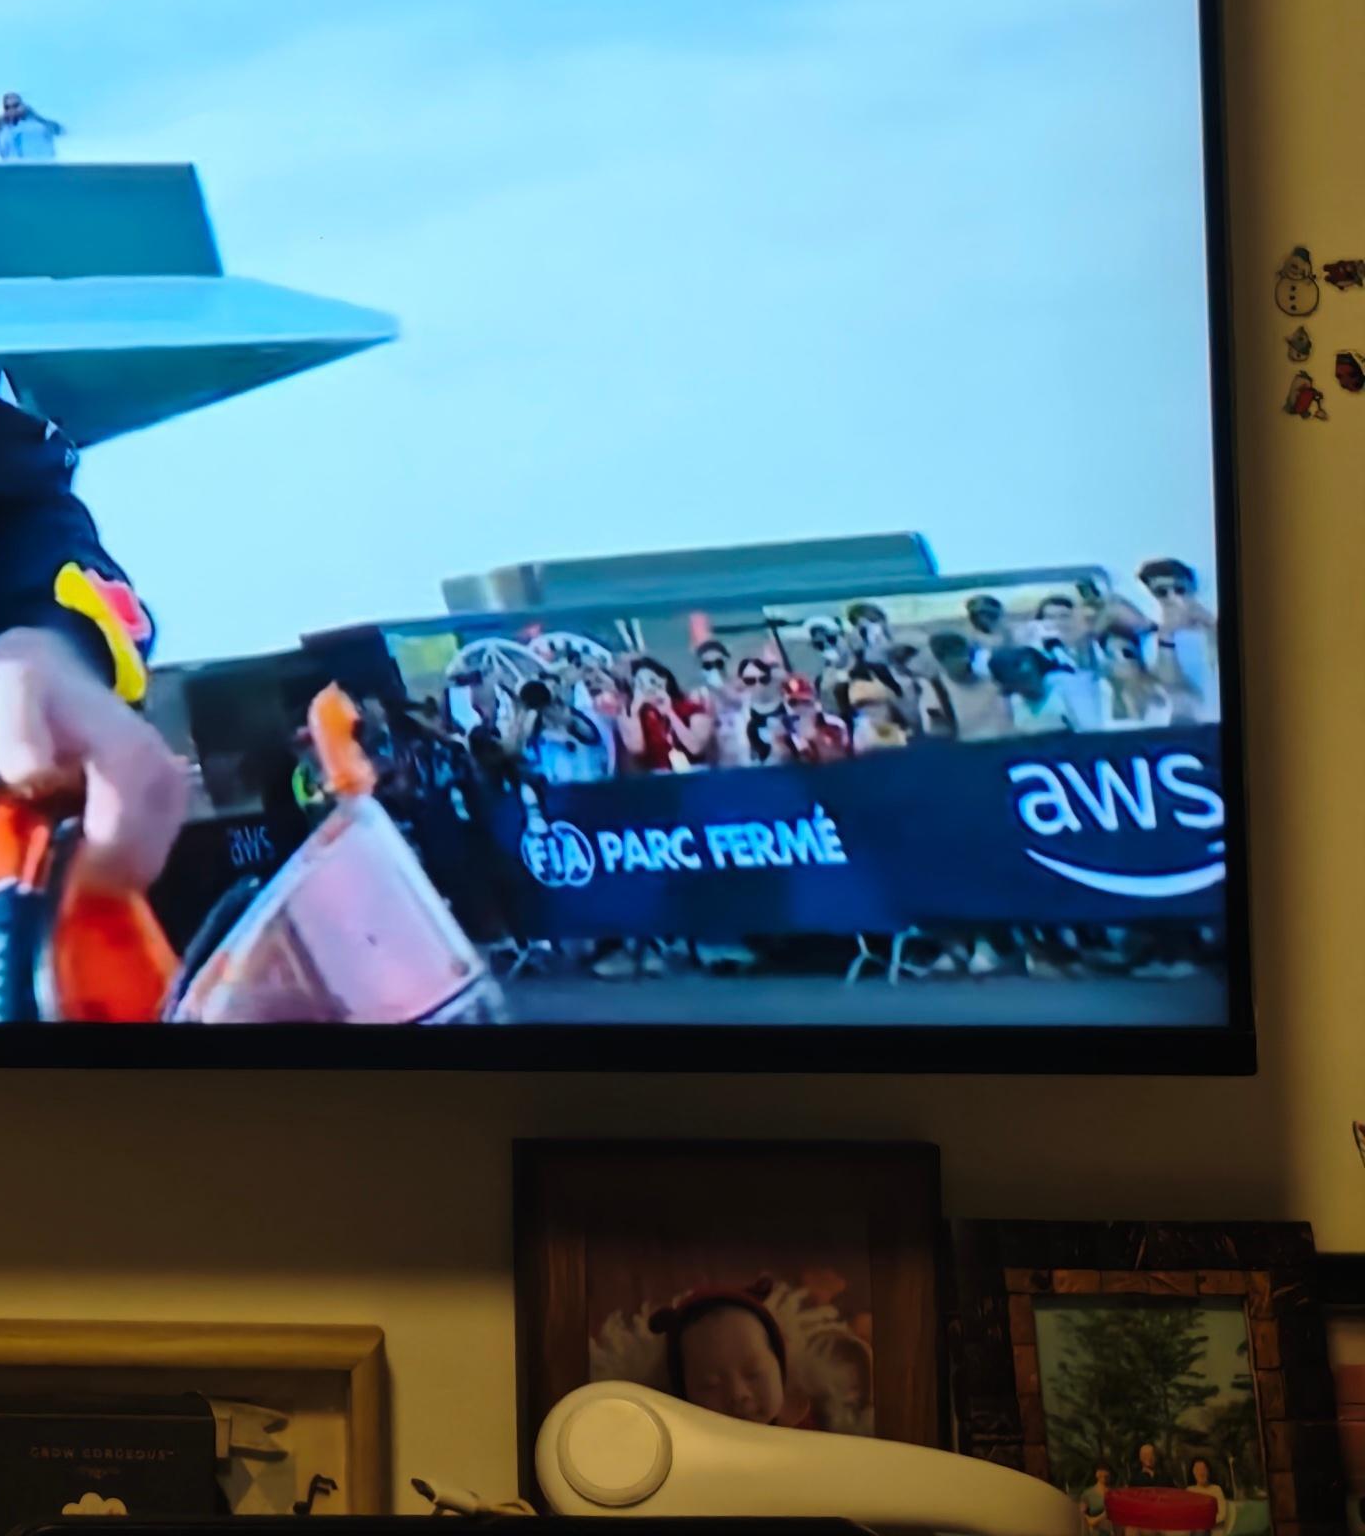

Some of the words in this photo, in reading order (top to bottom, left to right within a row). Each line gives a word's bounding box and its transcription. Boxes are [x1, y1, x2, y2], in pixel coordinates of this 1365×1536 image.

[1008, 753, 1225, 836] aws
[526, 834, 588, 880] FIA
[600, 832, 700, 874] PARC
[705, 804, 847, 869] FERMÉ
